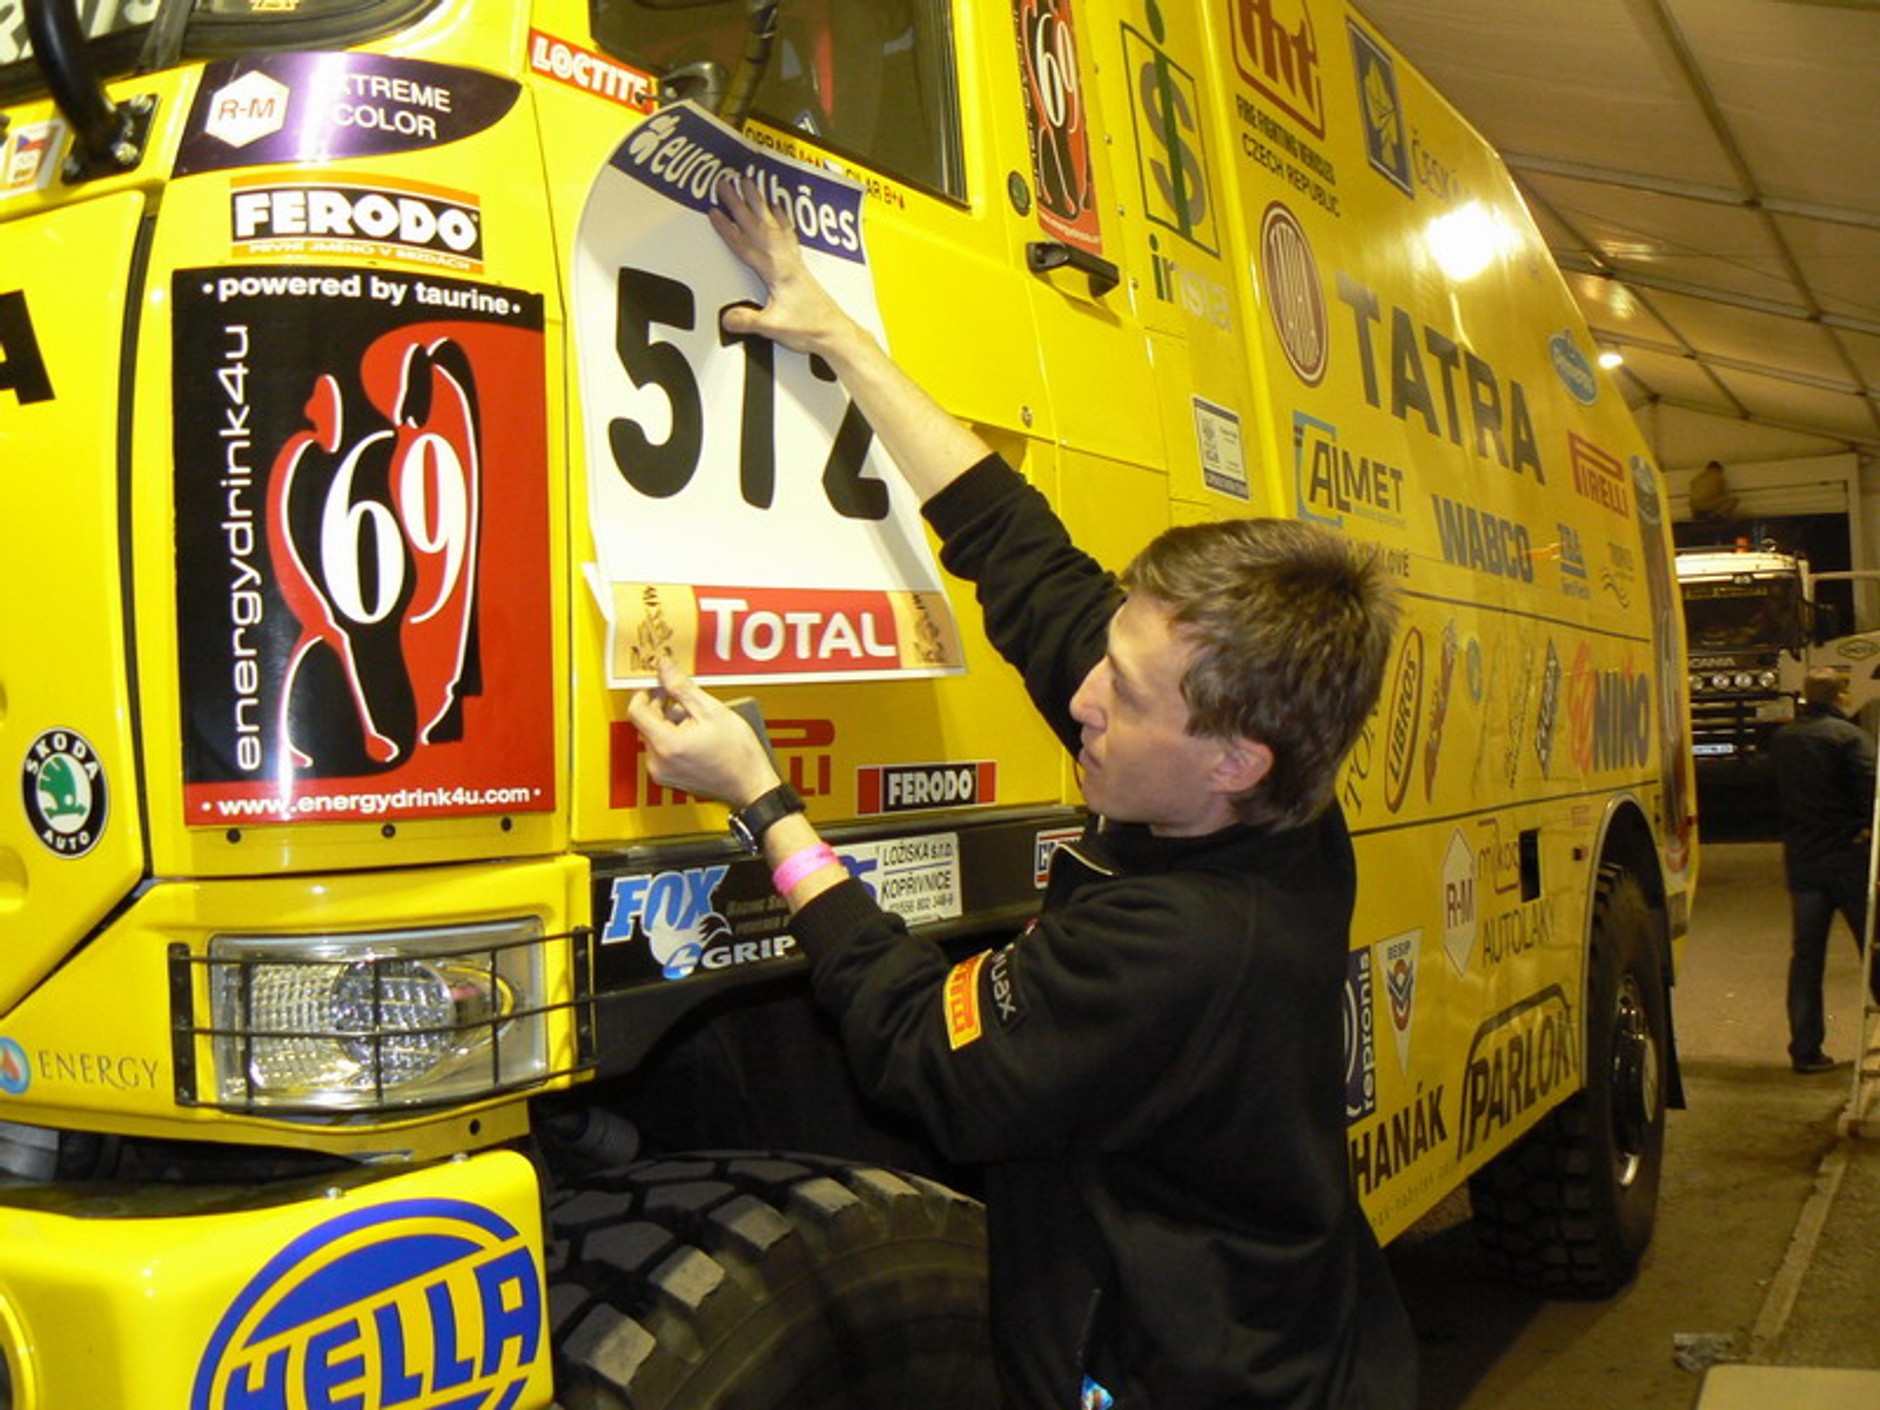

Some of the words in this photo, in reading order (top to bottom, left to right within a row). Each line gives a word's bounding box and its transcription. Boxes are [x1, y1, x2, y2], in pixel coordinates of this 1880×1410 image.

[328, 72, 452, 113] XTREME
[531, 37, 649, 105] LOCTITE
[217, 96, 277, 121] R-M
[332, 104, 437, 140] COLOR
[234, 190, 478, 252] FERODO
[217, 275, 361, 301] powered
[371, 275, 407, 306] by
[415, 281, 510, 314] taurine
[1336, 270, 1546, 486] TATRA
[1309, 439, 1404, 513] ALMET
[1568, 430, 1630, 519] PIRELLI
[217, 325, 262, 771] energydrink4u
[320, 429, 468, 624] 69
[1432, 493, 1534, 584] WABCO
[698, 596, 899, 661] TOTAL
[217, 786, 530, 817] www.energydrink4u.com
[887, 768, 974, 806] FERODO
[42, 828, 91, 850] AUTO
[601, 864, 730, 945] FOX
[701, 934, 797, 970] GRIP
[37, 1050, 162, 1090] ENERGY
[1351, 1080, 1448, 1197] HANÁK
[221, 1244, 542, 1410] HELLA
